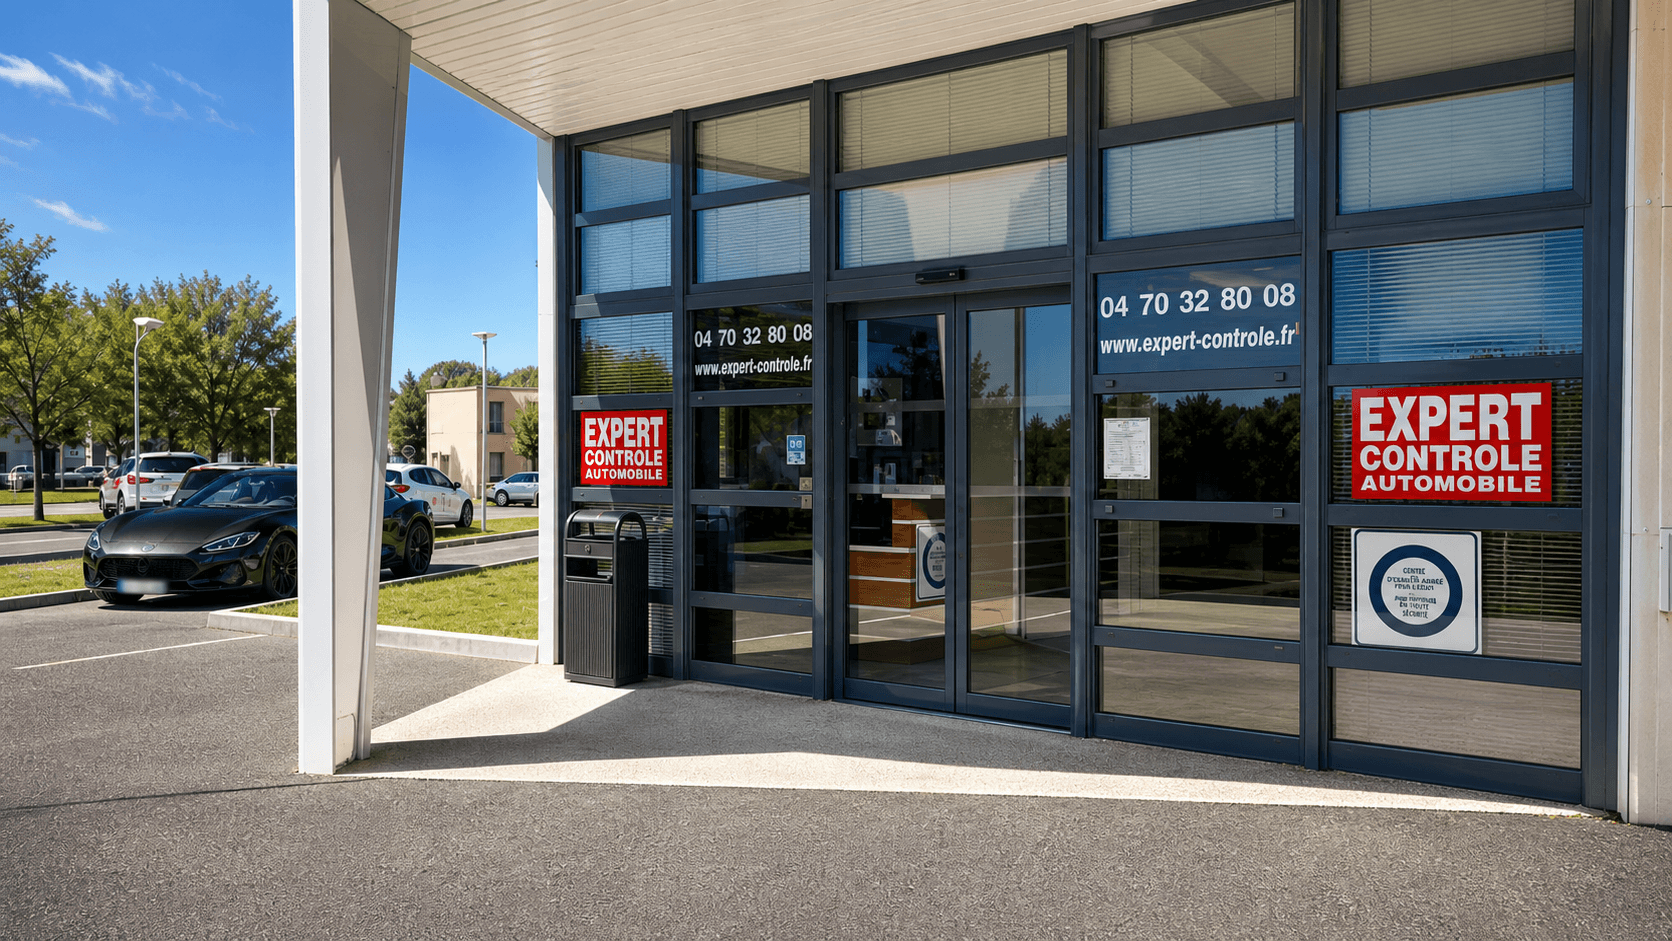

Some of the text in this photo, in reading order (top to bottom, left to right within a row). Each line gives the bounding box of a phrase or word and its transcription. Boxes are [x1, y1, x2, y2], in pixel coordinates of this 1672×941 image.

[1100, 283, 1296, 318] 04 70 32 80 08
[694, 323, 813, 348] 04 70 32 80 08
[1100, 324, 1296, 356] www.expert-controle.fr
[694, 354, 813, 378] www.expert-controle.fr
[1360, 392, 1542, 442] EXPERT
[584, 416, 664, 448] EXPERT
[584, 449, 663, 467] CONTROLE
[1360, 444, 1542, 472] CONTROLE
[585, 468, 663, 480] AUTOMOBILE
[1360, 475, 1541, 493] AUTOMOBILE
